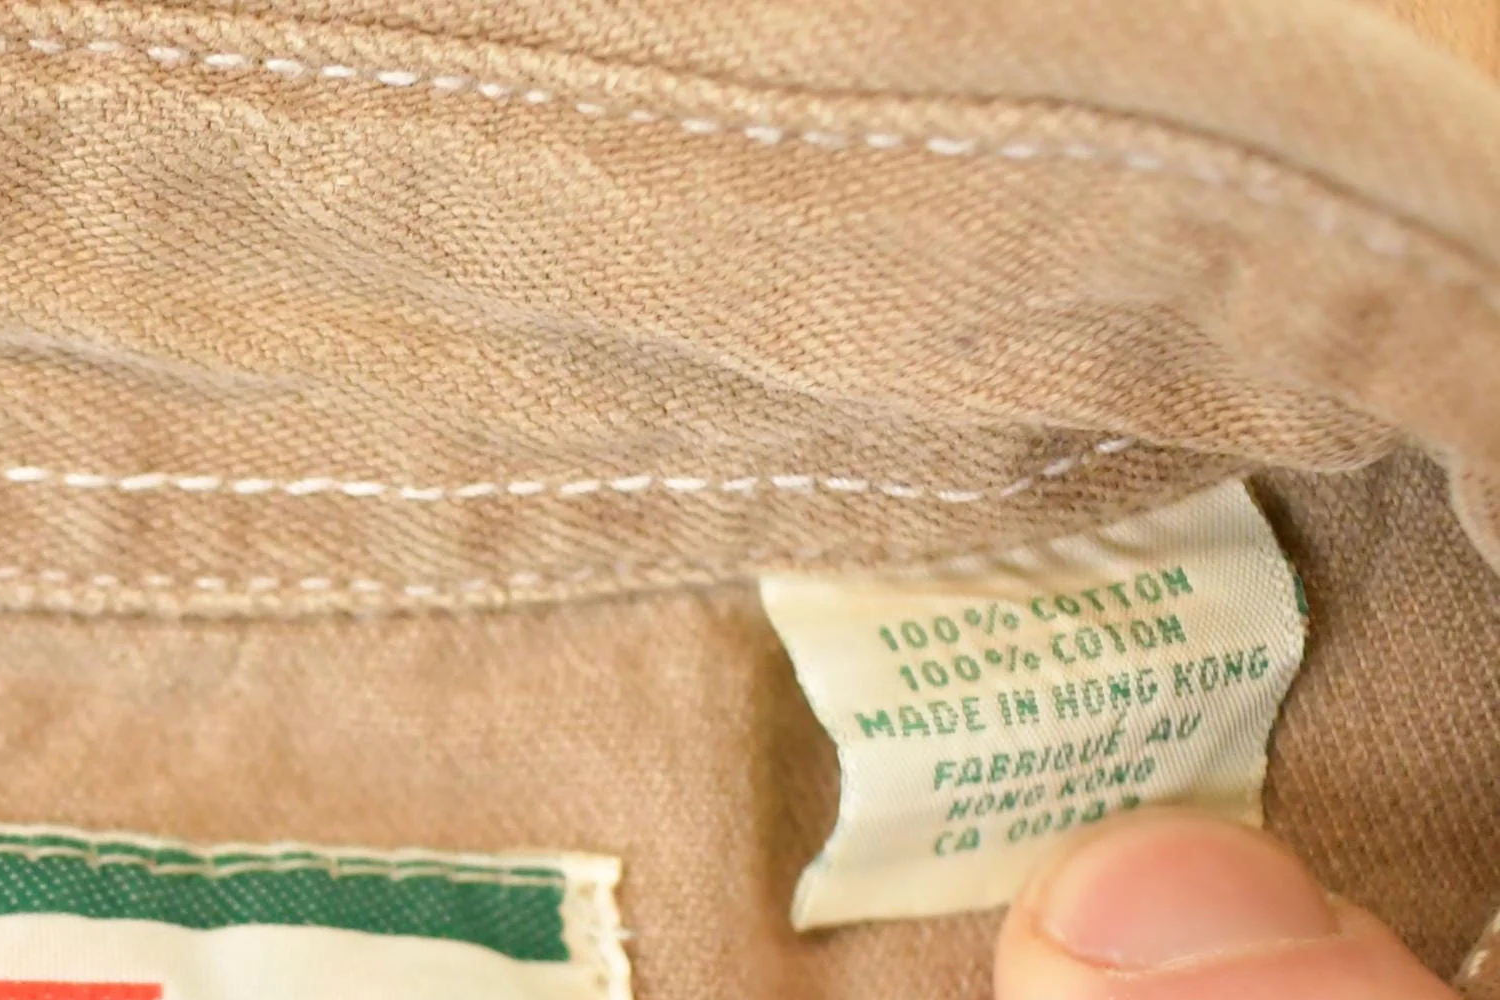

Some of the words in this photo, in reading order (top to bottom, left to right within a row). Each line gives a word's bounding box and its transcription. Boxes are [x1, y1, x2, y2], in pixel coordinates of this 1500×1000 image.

[878, 602, 1021, 653] 100%
[1030, 566, 1194, 623] COTTON
[853, 695, 988, 740] MADE
[998, 688, 1042, 726] IN
[1050, 668, 1160, 720] HONG
[1172, 642, 1270, 698] KONG
[898, 645, 1042, 692] 100%
[1050, 612, 1187, 665] COTON
[1145, 711, 1202, 744] AU
[1057, 756, 1156, 799] KONG
